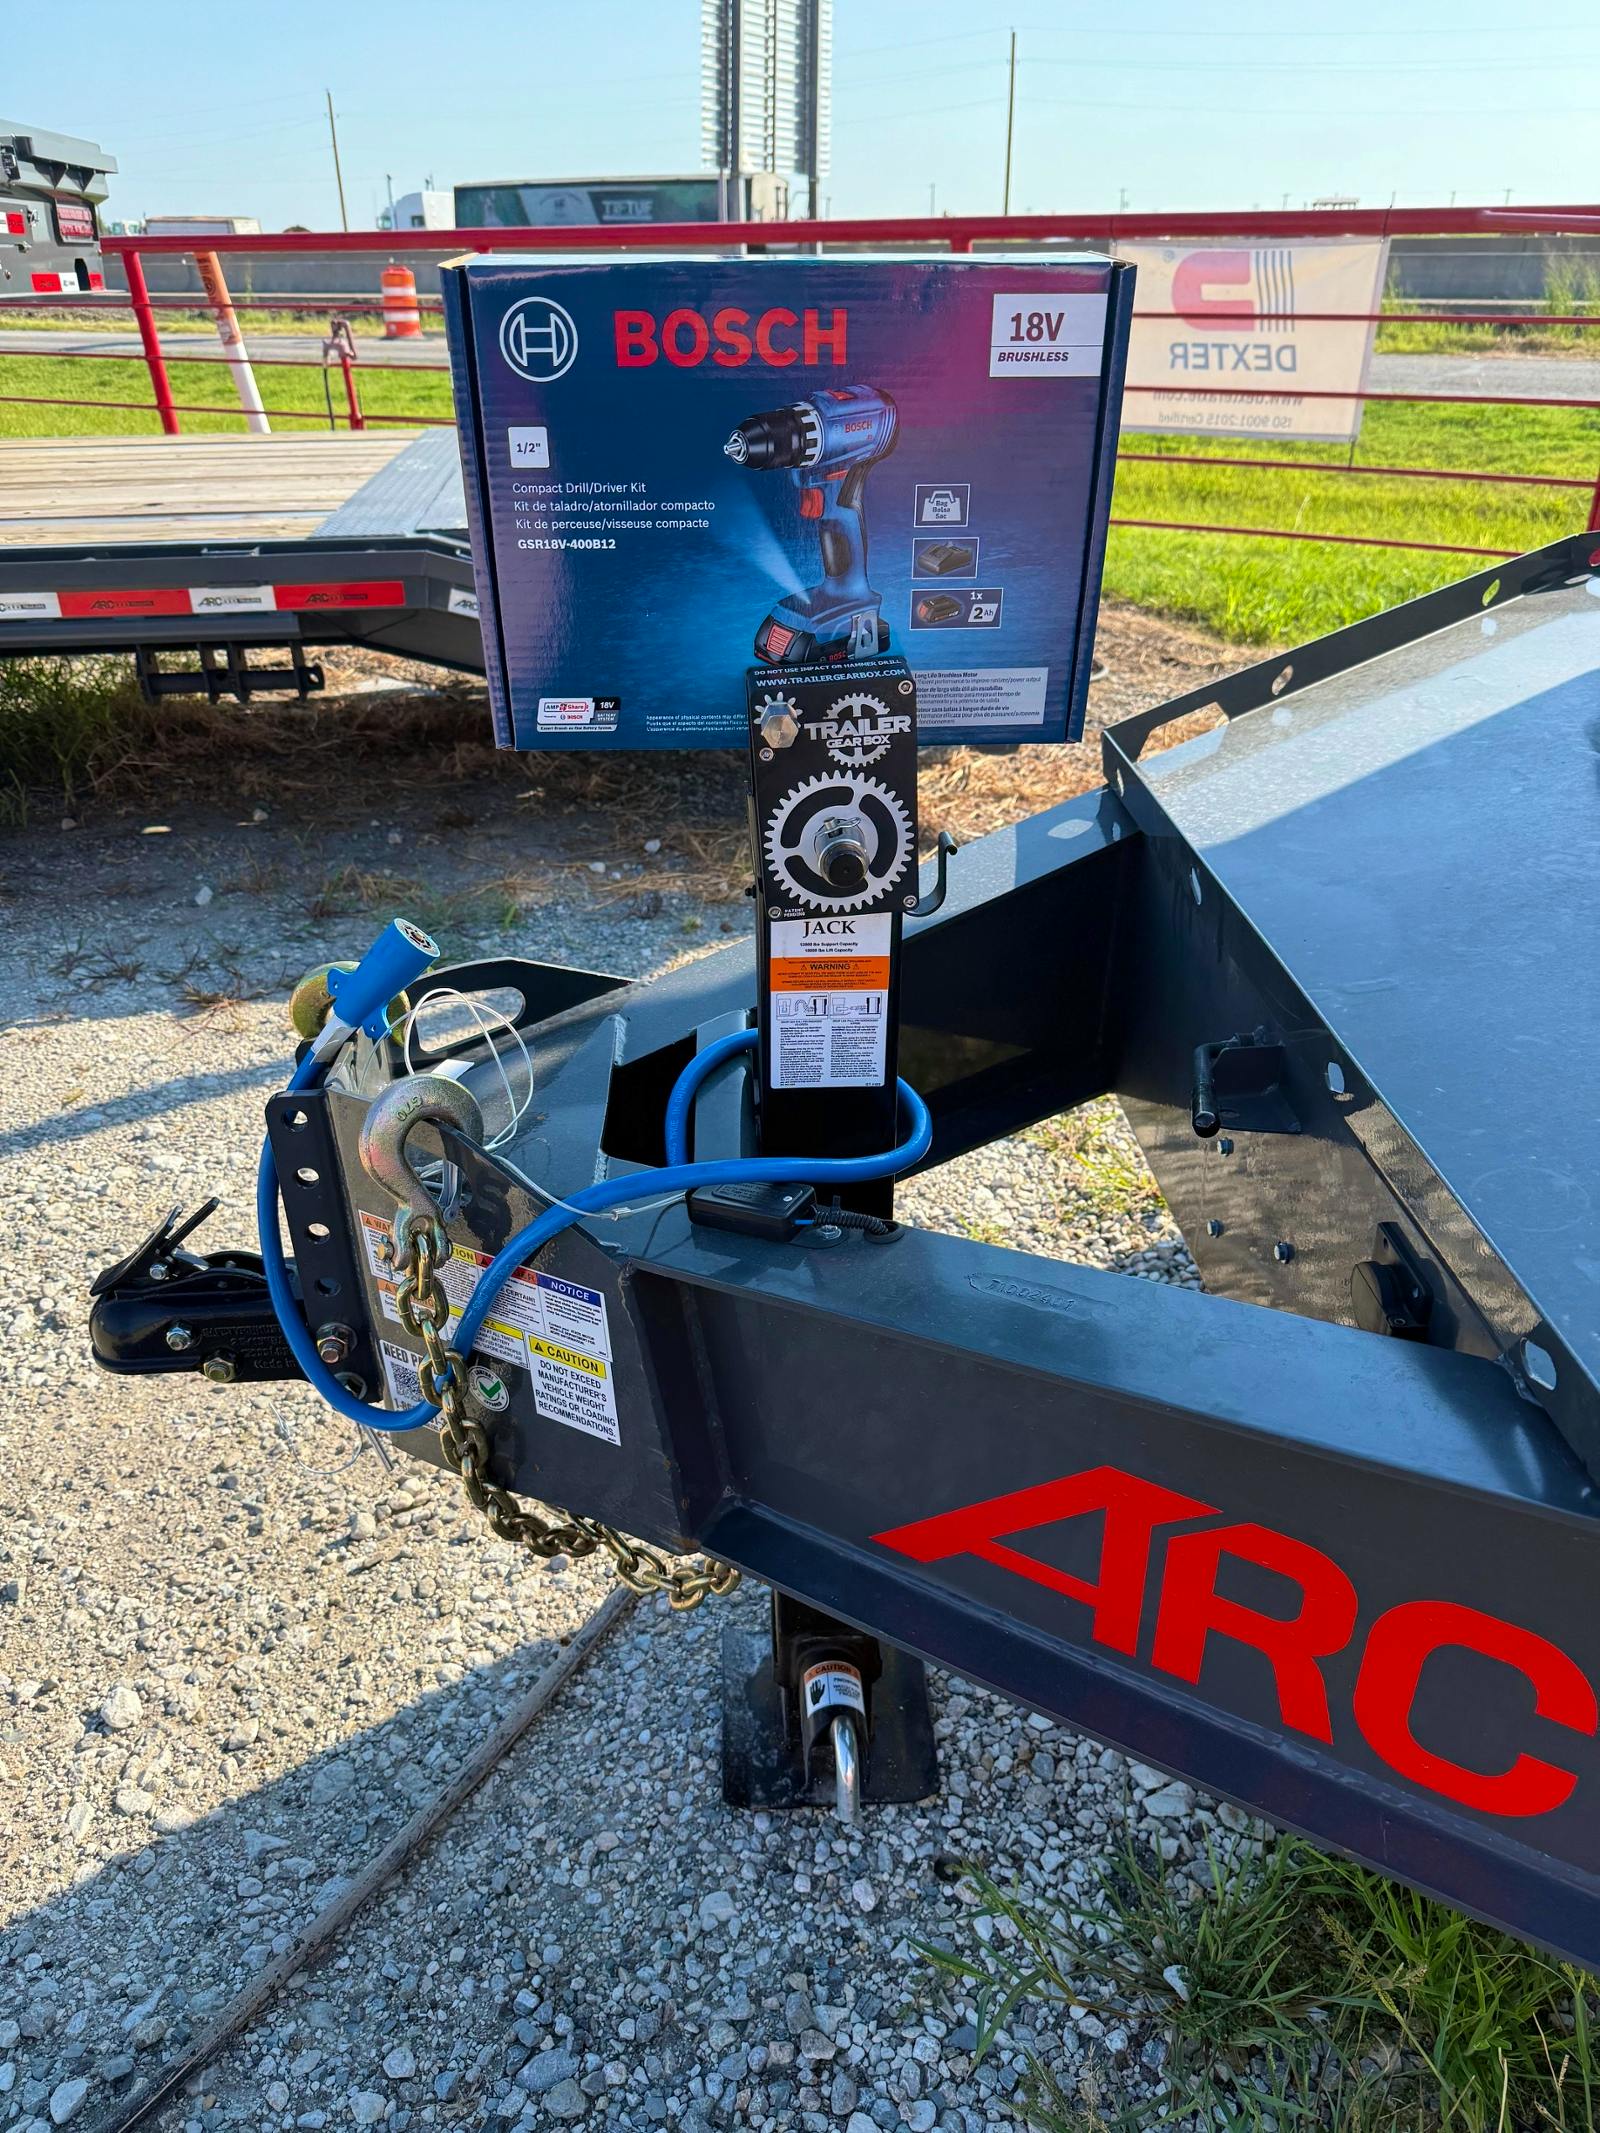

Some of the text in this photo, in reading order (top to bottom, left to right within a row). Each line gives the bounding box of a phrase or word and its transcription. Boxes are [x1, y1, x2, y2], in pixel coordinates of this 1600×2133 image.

[1010, 312, 1065, 341] 18V
[614, 307, 848, 367] BOSCH
[998, 352, 1069, 362] BRUSHLESS
[844, 420, 872, 433] BOSCH
[516, 443, 541, 453] 1/2"
[513, 482, 647, 495] Compact Drill/Driver Kit
[514, 500, 716, 512] Kit de taladro/atornillador compacto
[516, 518, 709, 530] Kit de perceuse/visseuse compacte
[518, 539, 616, 549] GSR18V-400B12
[970, 591, 983, 600] 1x
[756, 669, 907, 687] WWW.TRAILERGEARBOX.COM
[804, 715, 912, 740] TRAILER
[803, 920, 856, 939] JACK
[551, 1281, 590, 1300] NOTICE
[383, 1342, 409, 1363] NEED
[547, 1346, 599, 1372] CAUTION
[540, 1360, 601, 1389] DO NOT EXCEED
[538, 1370, 607, 1402] MANUFACTURER'S
[542, 1381, 605, 1412] VEHICLE WEIGHT
[535, 1389, 616, 1427] RATINGS OR LOADING
[539, 1401, 616, 1437] RECOMMENDATIONS.
[869, 1464, 1598, 1818] ARC
[815, 1663, 852, 1674] CAUTION
